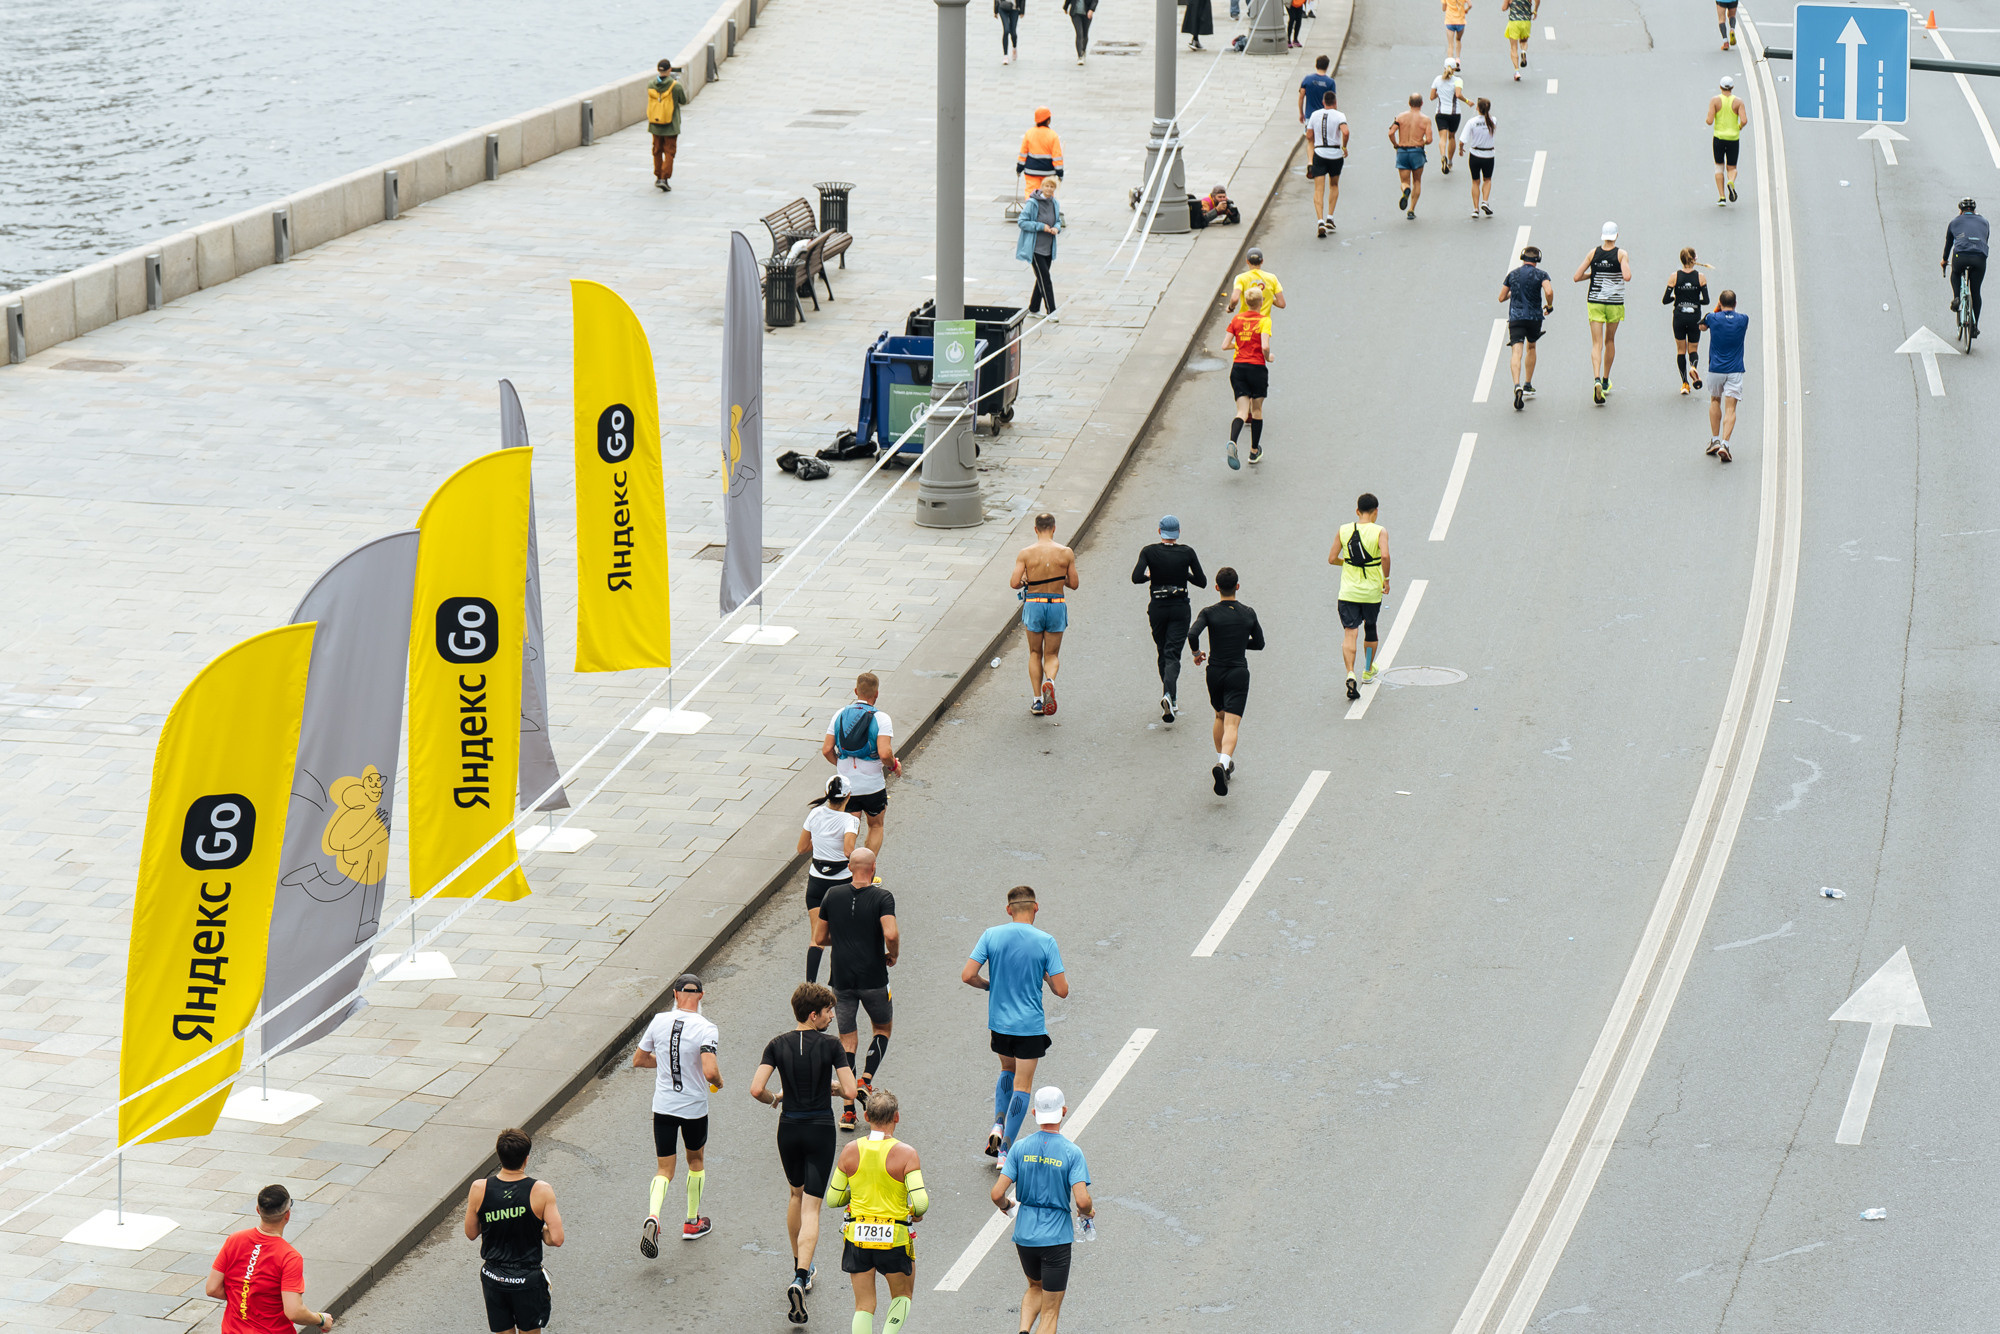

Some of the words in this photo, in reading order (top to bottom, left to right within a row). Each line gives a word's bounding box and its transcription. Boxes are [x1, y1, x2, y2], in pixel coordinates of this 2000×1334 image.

[606, 410, 626, 457] Go
[607, 470, 634, 592] Яндекс
[447, 604, 487, 657] Go
[453, 674, 494, 809] Яндекс
[195, 802, 242, 862] Go
[172, 881, 232, 1044] Яндекс
[1023, 1154, 1038, 1163] DIE
[1039, 1155, 1063, 1168] HARD
[484, 1206, 527, 1223] RUNUP
[856, 1225, 892, 1238] 17816
[244, 1244, 262, 1280] МОСКВА
